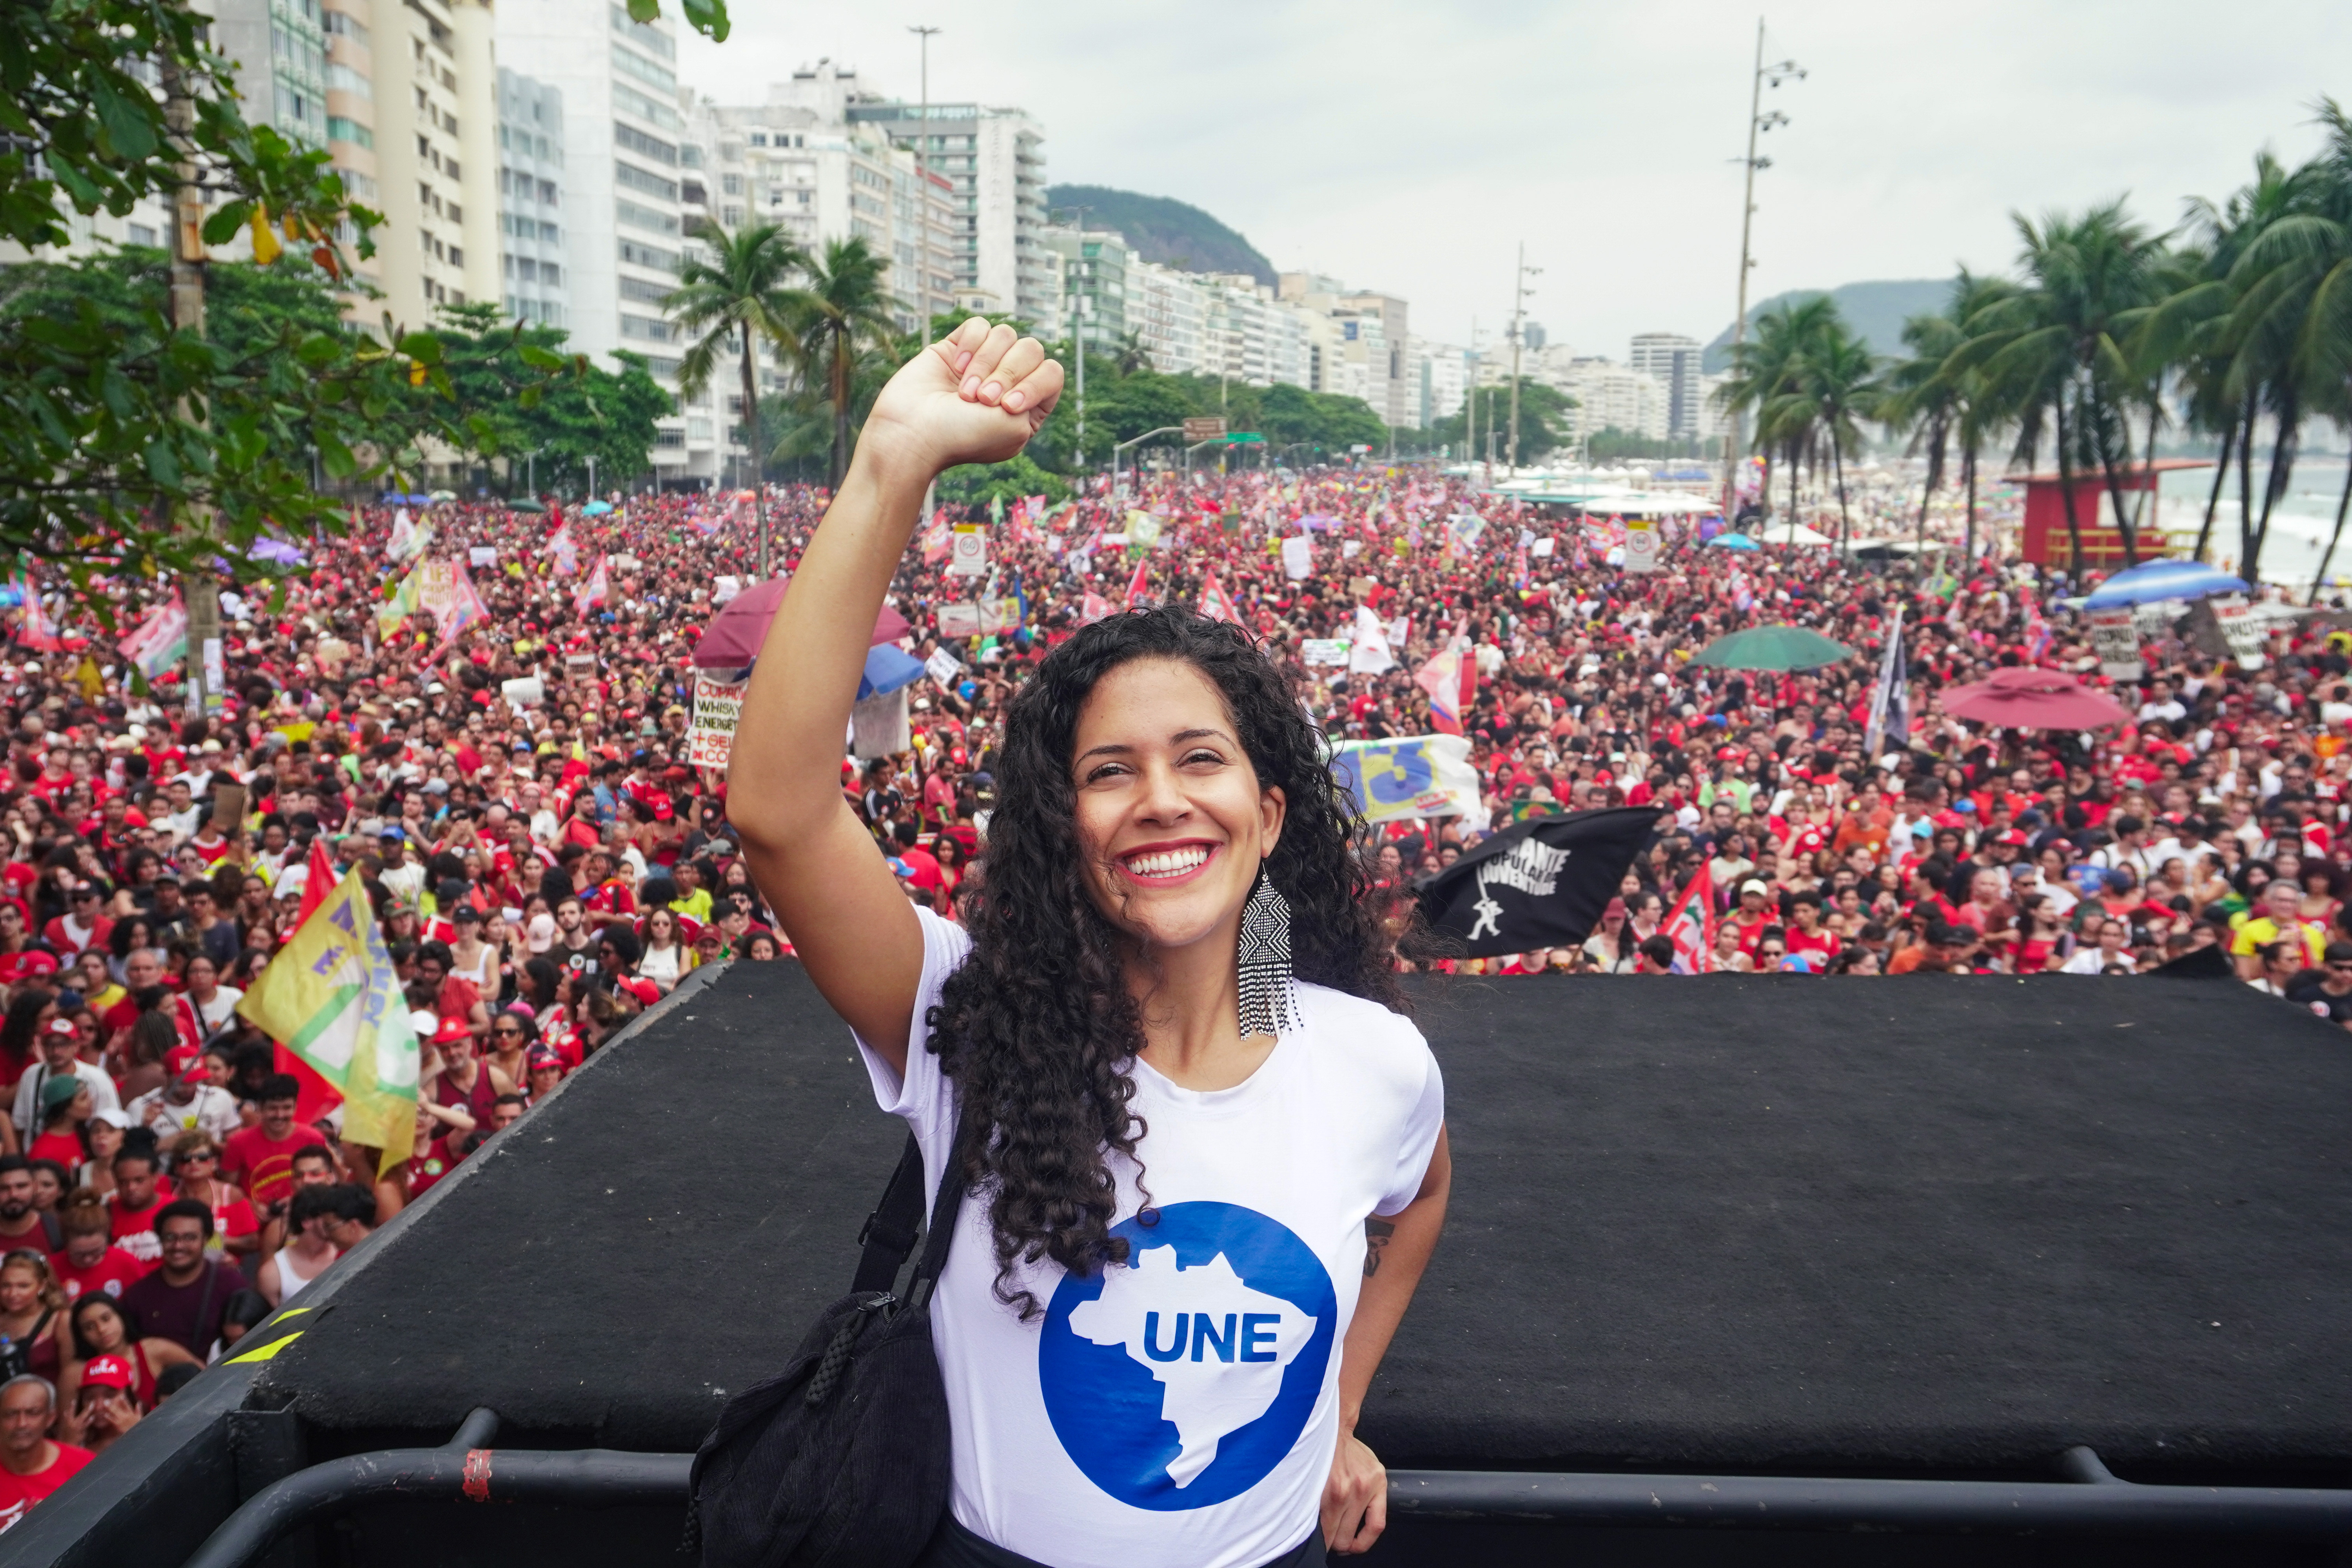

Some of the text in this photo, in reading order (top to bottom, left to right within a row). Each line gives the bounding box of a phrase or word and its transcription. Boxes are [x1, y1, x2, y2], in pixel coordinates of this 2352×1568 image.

[697, 699, 742, 717] WHISKY
[1483, 861, 1557, 896] JUVENTUDE
[1143, 1311, 1281, 1363] UNE
